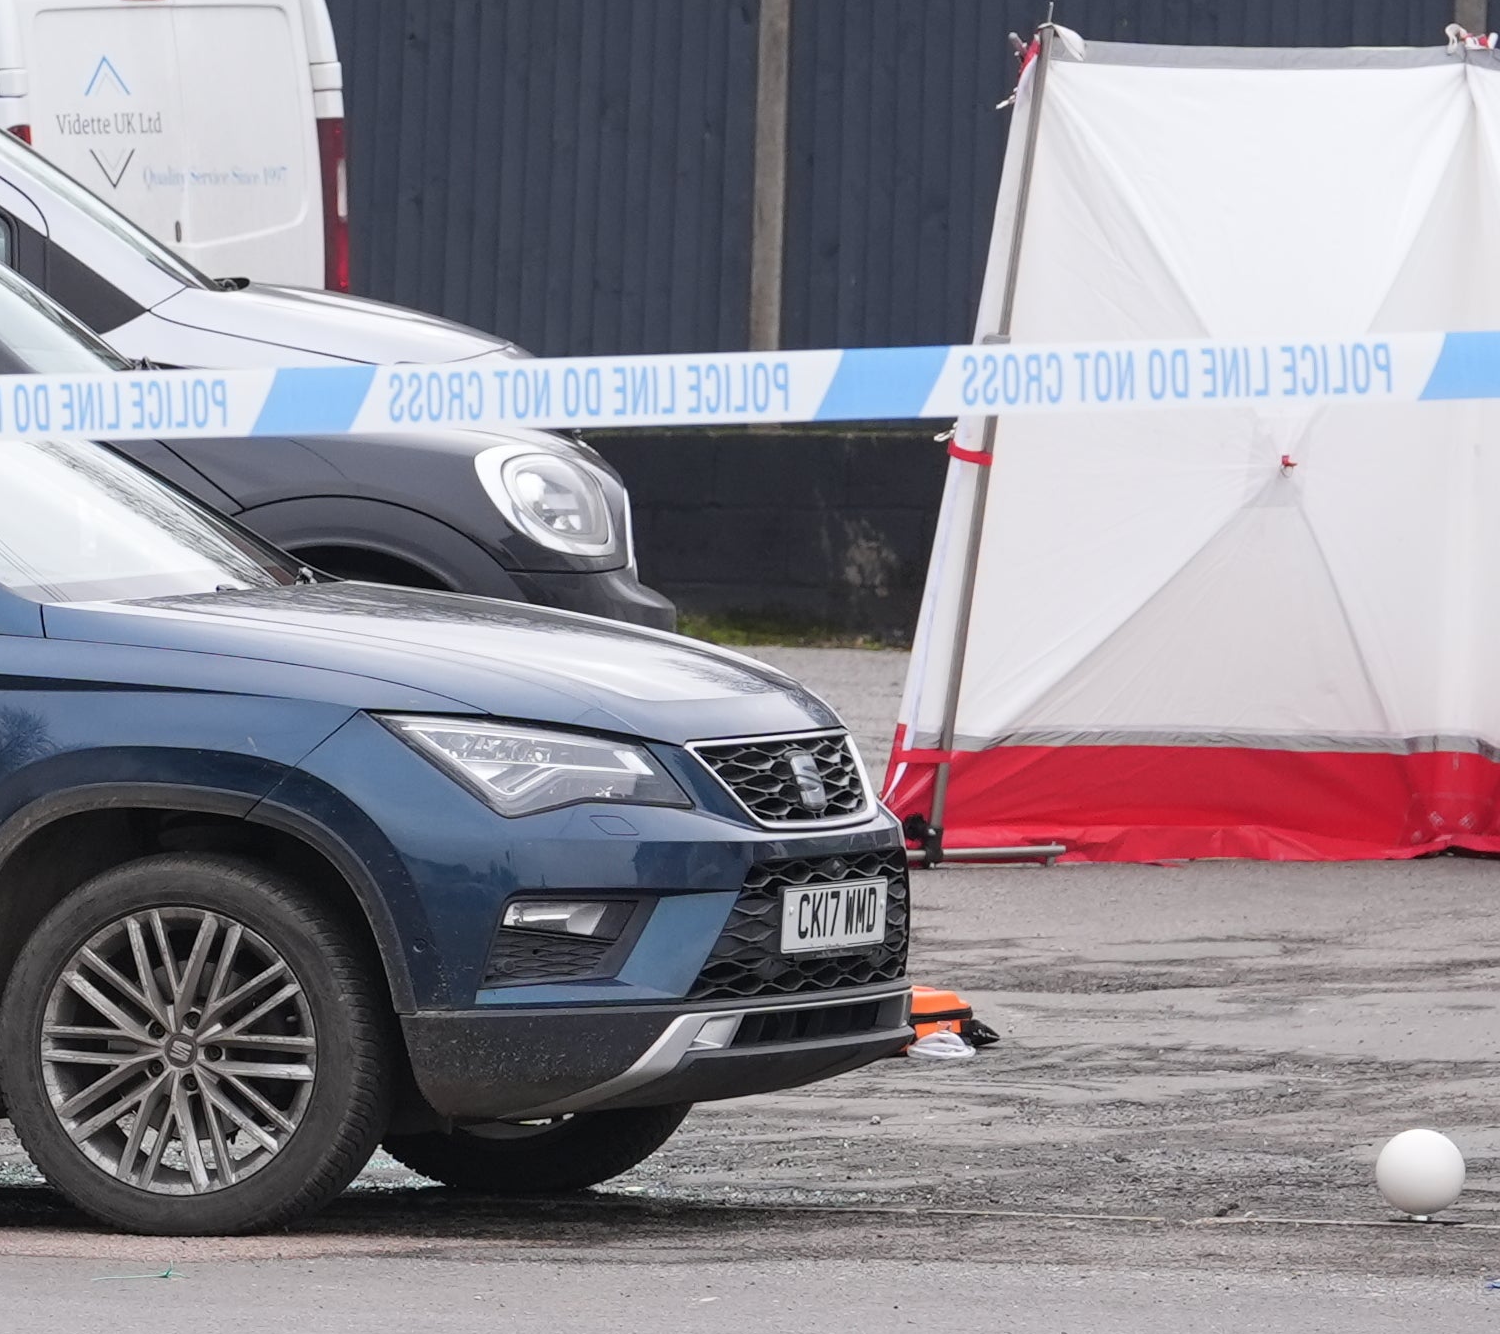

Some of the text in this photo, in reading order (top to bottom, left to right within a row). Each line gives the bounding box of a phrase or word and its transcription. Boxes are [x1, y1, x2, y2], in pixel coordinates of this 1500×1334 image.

[56, 112, 163, 135] Vidette UK Ltd
[190, 167, 229, 185] Service
[798, 887, 877, 939] CK17 WMD
